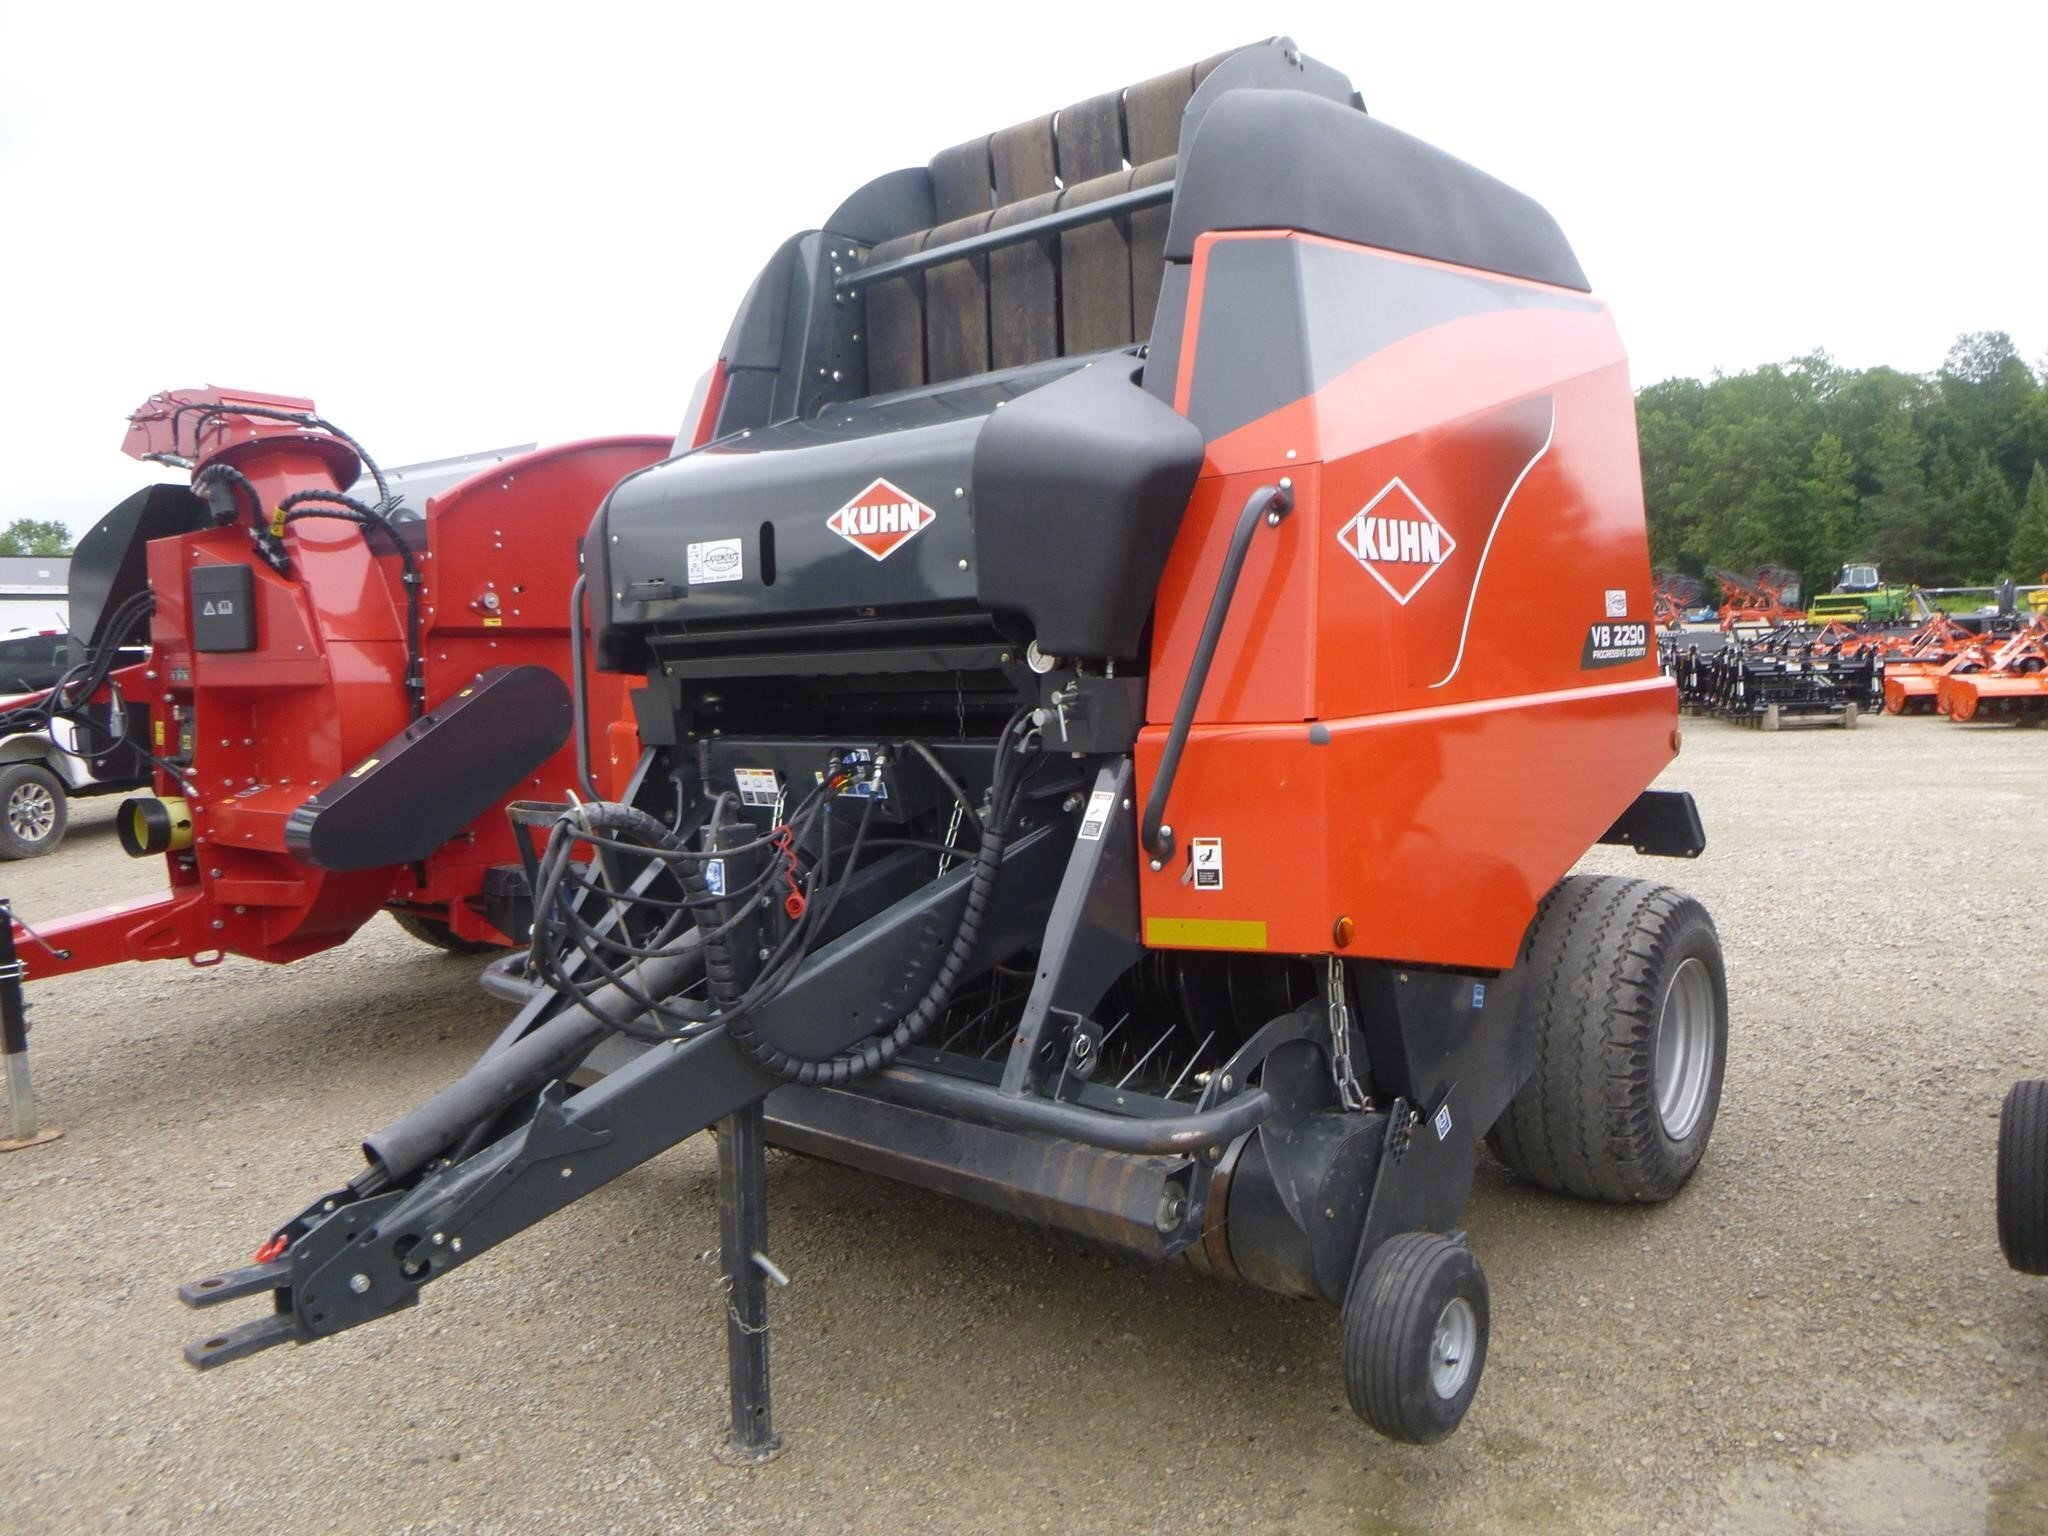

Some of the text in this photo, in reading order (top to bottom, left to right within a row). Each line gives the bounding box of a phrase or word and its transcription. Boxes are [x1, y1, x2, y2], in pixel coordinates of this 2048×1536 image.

[841, 503, 920, 535] KUHN
[1356, 516, 1441, 564] KUHN
[1591, 625, 1645, 647] VB 2290
[1592, 649, 1626, 660] PROGRESSIVE
